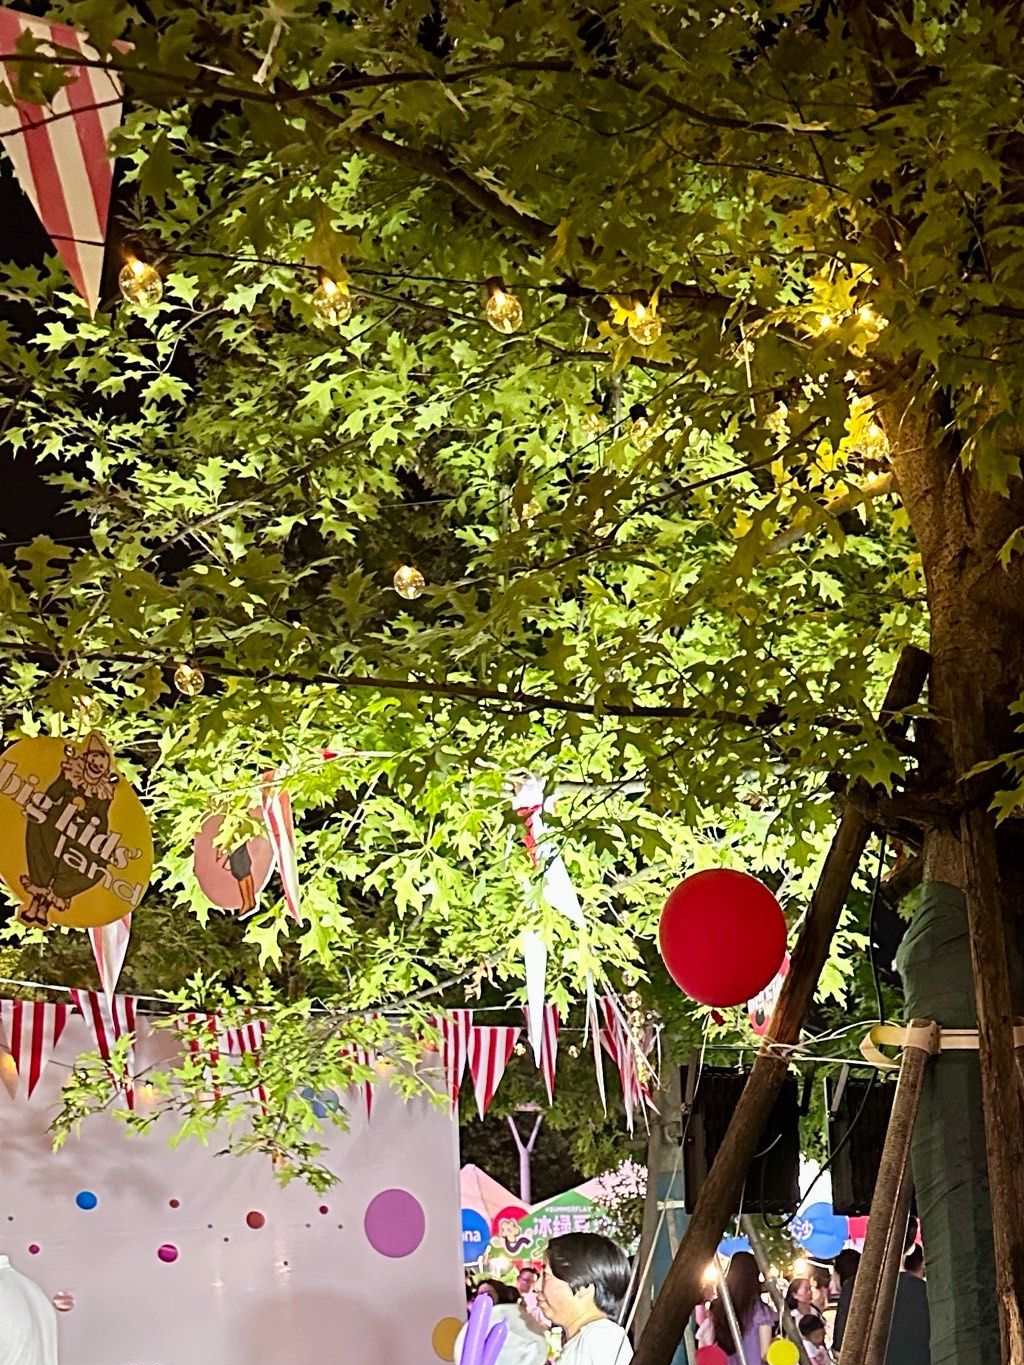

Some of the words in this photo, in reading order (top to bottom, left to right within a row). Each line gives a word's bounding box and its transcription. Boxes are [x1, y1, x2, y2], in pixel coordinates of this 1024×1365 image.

[0, 758, 64, 824] big
[54, 802, 143, 869] kids
[53, 834, 143, 906] land
